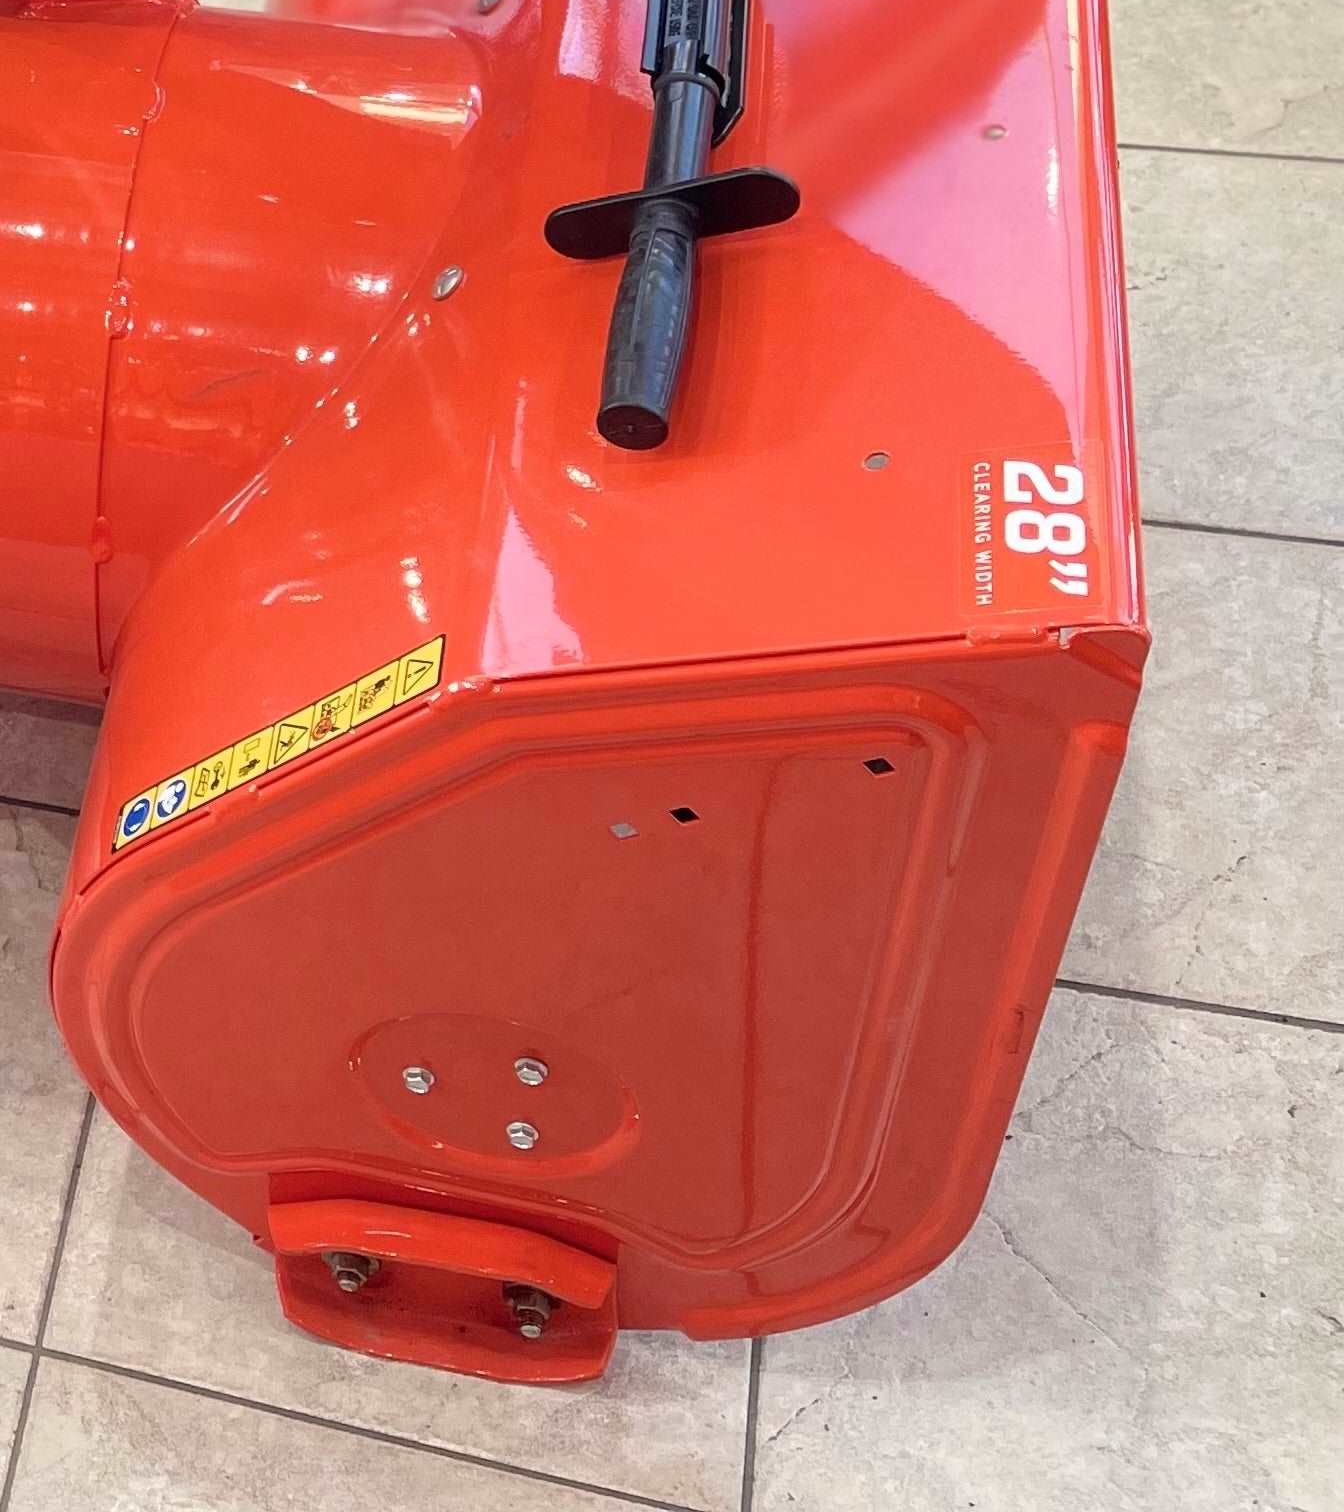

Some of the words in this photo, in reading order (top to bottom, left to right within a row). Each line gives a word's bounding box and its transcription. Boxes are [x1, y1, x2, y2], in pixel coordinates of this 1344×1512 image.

[973, 461, 992, 545] CLEARING
[1003, 460, 1089, 597] 28"
[975, 550, 993, 607] WIDTH
